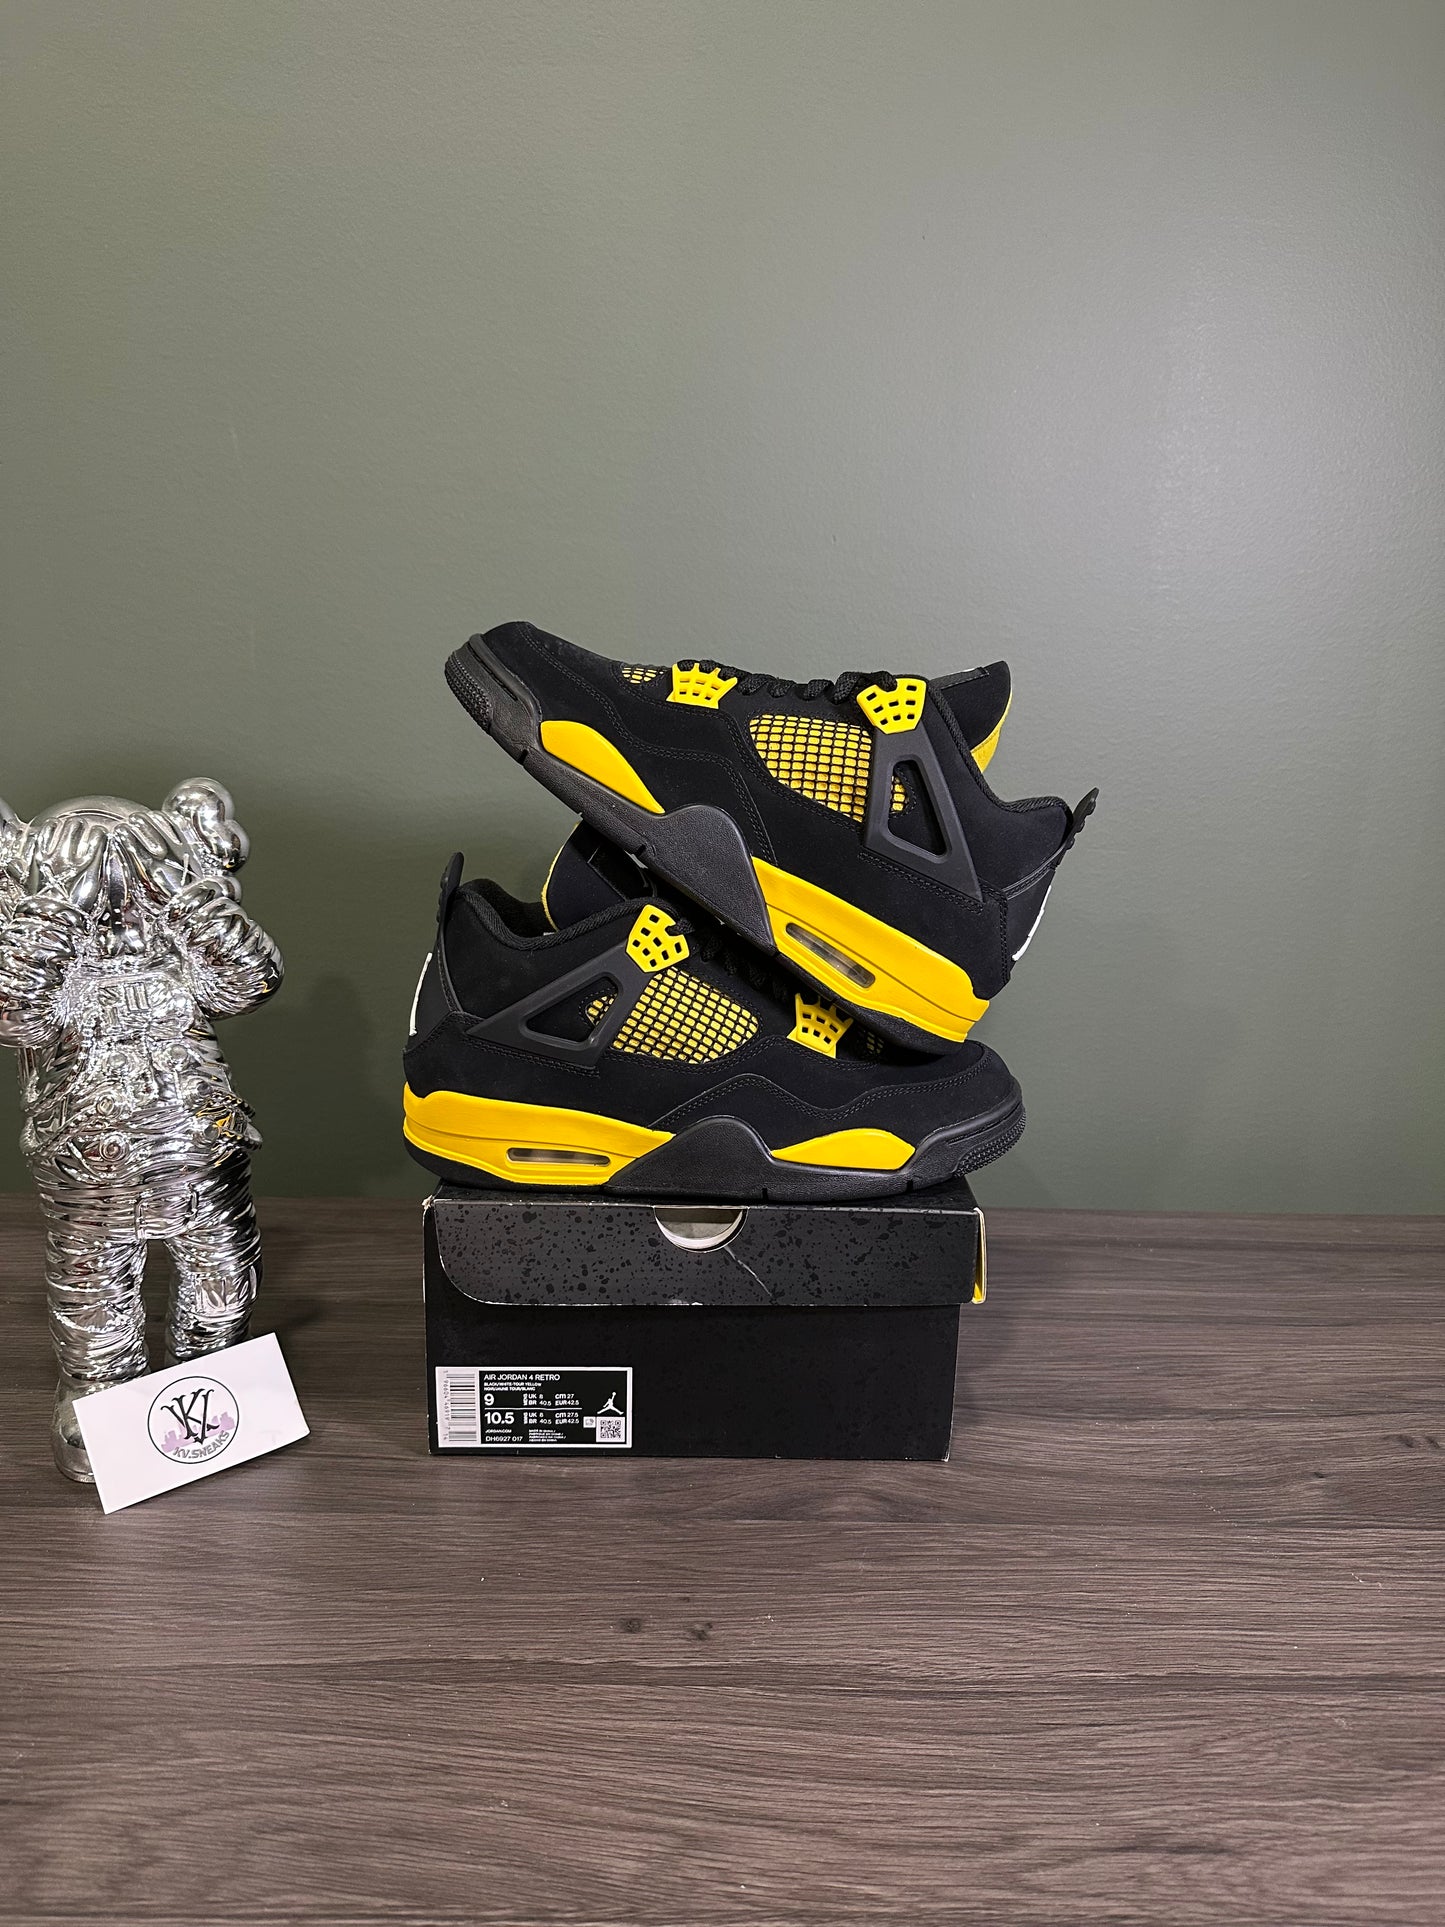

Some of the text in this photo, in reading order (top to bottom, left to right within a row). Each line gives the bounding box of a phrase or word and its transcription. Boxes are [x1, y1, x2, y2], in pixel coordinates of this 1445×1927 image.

[484, 1393, 495, 1406] 9
[484, 1411, 515, 1425] 10.5
[173, 1430, 230, 1459] KV.SNEAKS
